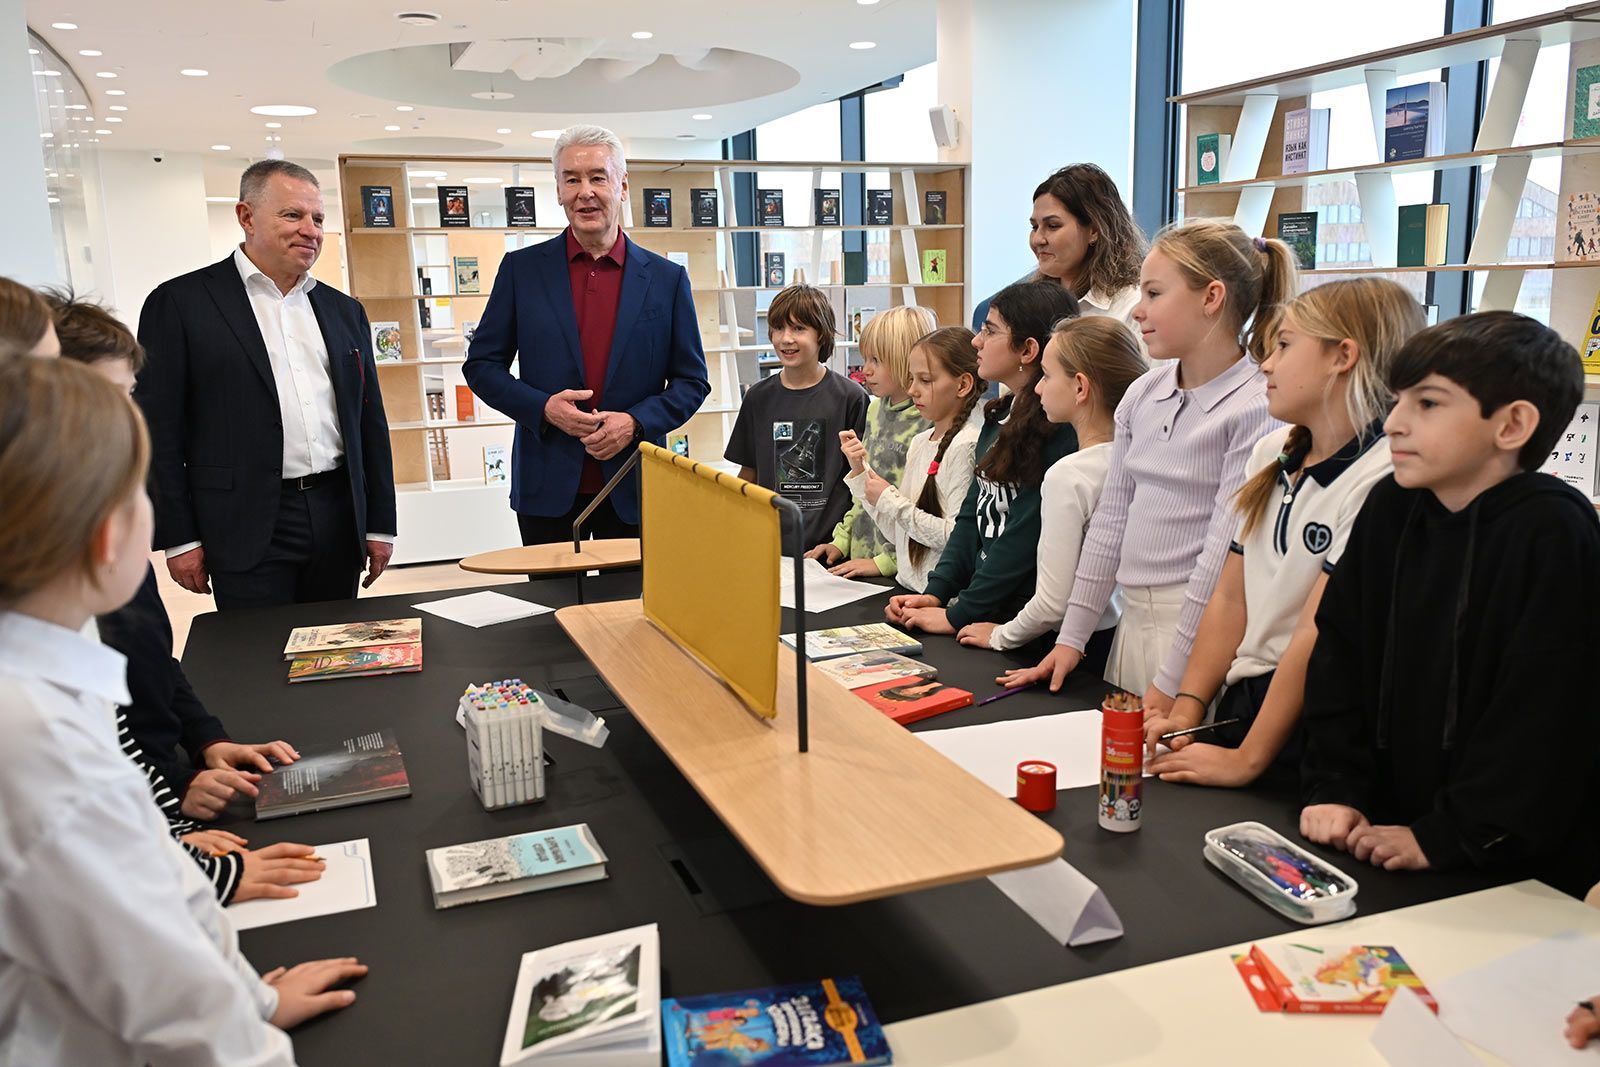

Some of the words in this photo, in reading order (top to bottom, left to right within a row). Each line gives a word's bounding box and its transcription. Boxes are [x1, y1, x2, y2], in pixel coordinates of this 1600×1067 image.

[1286, 116, 1307, 130] СТИВЕН
[1285, 143, 1297, 152] ЯЗЫК
[1298, 141, 1307, 151] КАК
[1285, 151, 1307, 161] ИНСТИНКТ
